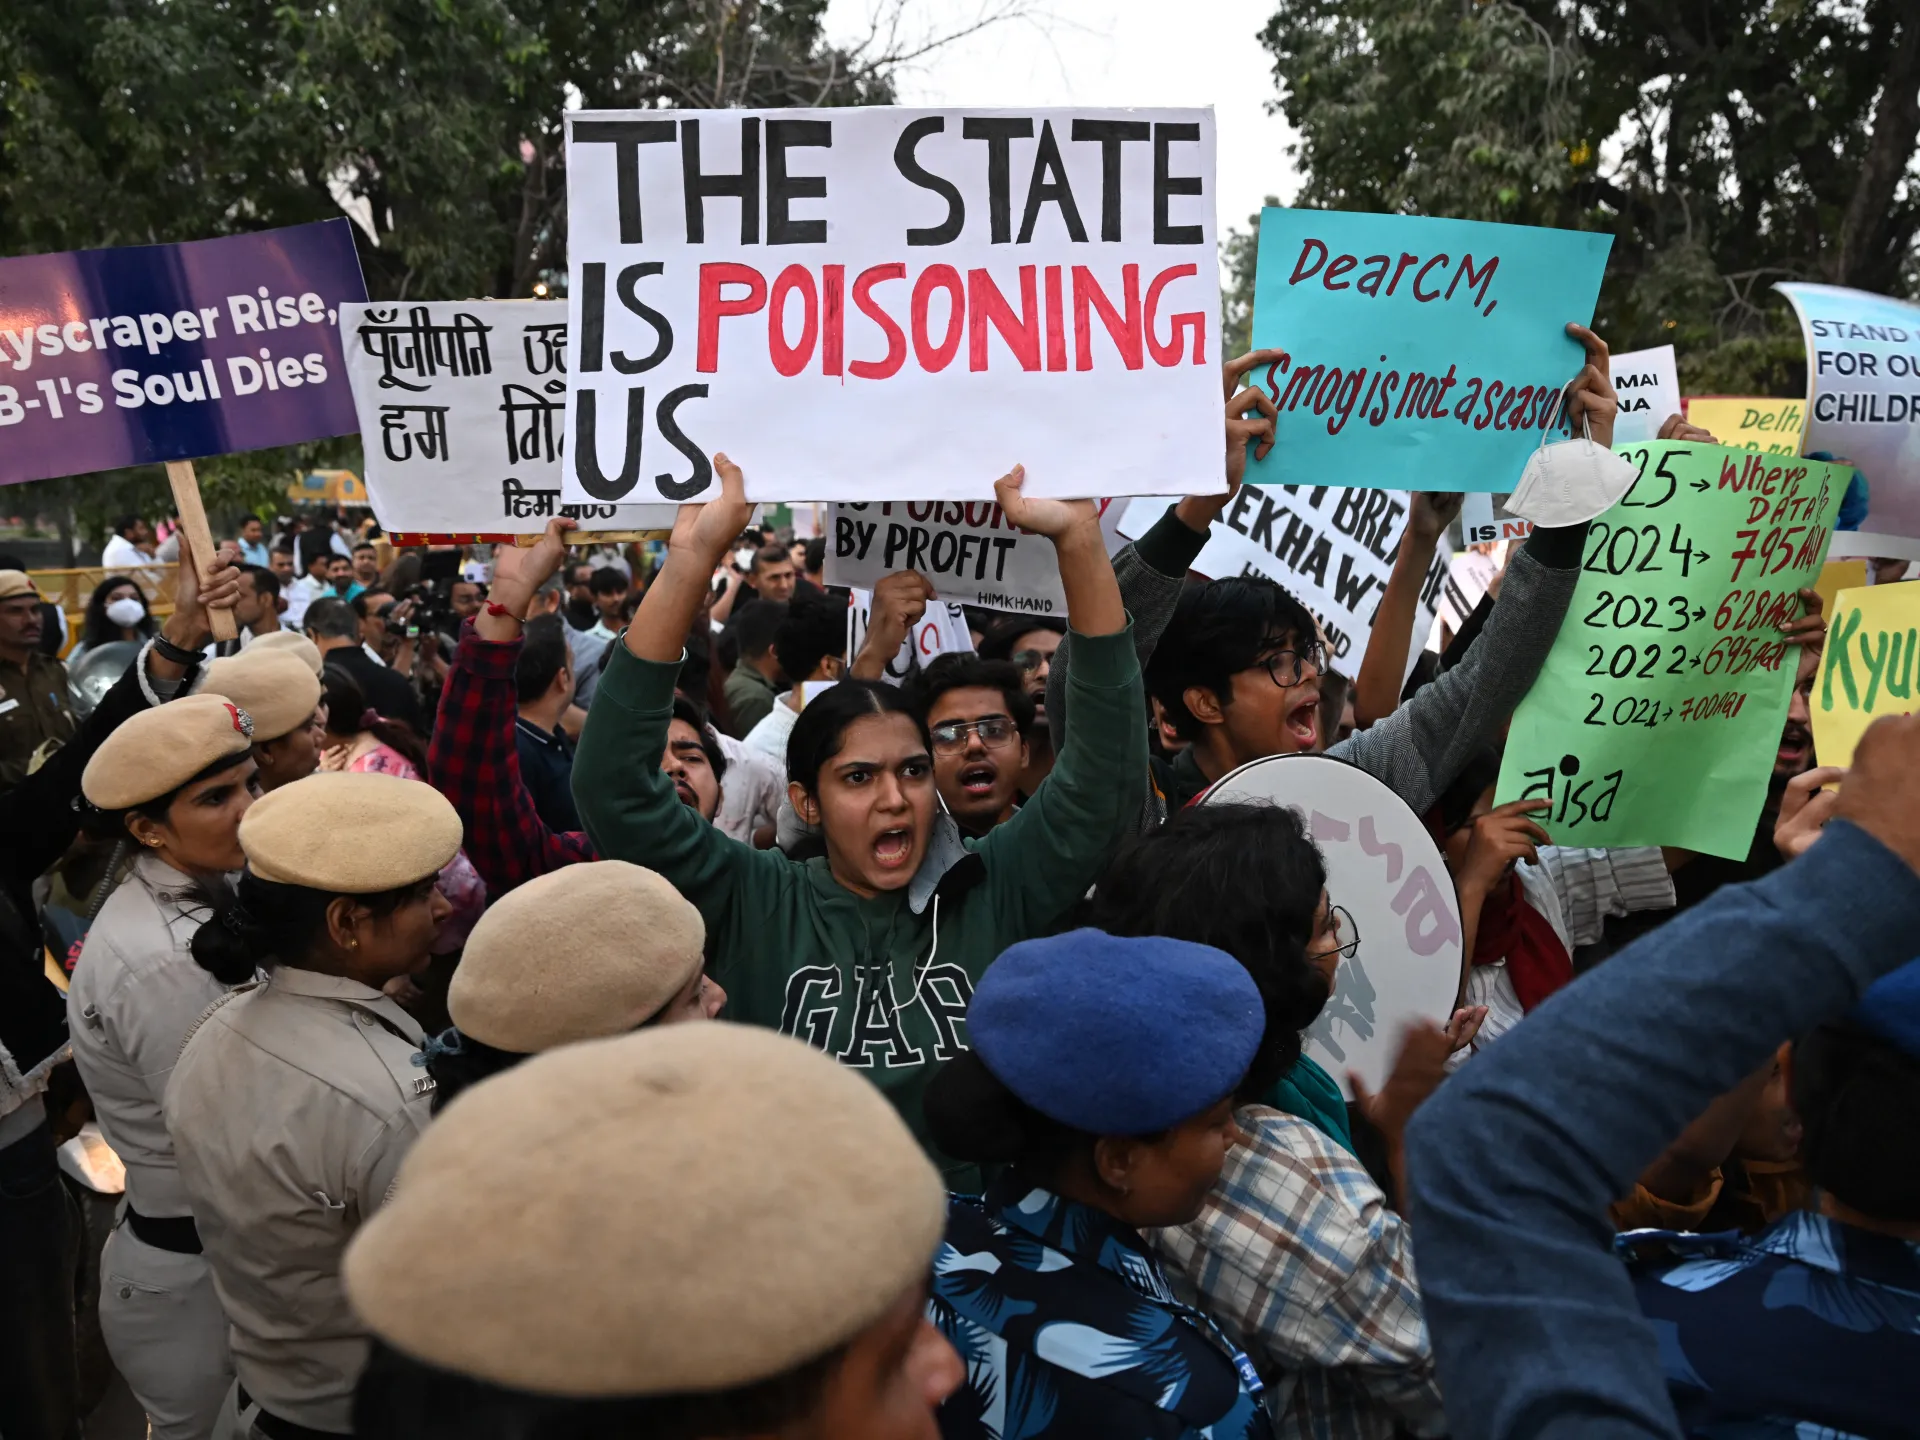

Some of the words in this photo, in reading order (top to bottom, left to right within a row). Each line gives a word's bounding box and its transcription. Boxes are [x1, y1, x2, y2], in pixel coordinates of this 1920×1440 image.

[573, 117, 832, 245] THE
[894, 116, 1204, 246] STATE
[1289, 238, 1419, 298] Dear
[1412, 253, 1500, 317] CM,
[0, 306, 220, 371] yscraper
[227, 285, 338, 335] Rise,
[580, 261, 673, 375] IS
[696, 261, 1207, 384] POISONING
[1811, 319, 1909, 343] STAND
[111, 358, 222, 409] Soul
[227, 347, 328, 397] Dies
[1615, 373, 1658, 390] MAI
[1817, 350, 1878, 376] FOR
[1265, 353, 1367, 436] Smog
[1360, 355, 1400, 427] is
[1394, 364, 1457, 419] not
[1454, 377, 1483, 425] a
[1739, 404, 1802, 434] Delh
[379, 404, 450, 462] हम
[573, 383, 713, 502] US
[1618, 448, 1693, 509] 25
[1717, 454, 1808, 498] Where
[835, 516, 877, 560] BY
[884, 523, 1016, 581] PROFIT
[1213, 484, 1333, 588] EKHA
[1470, 525, 1497, 542] IS
[1583, 522, 1692, 577] 2024
[978, 591, 1053, 612] HIMKHAND
[1583, 590, 1690, 632] 2023
[1585, 644, 1687, 678] 2022
[1821, 607, 1920, 714] Kyu
[1583, 692, 1661, 728] 2021
[1519, 754, 1623, 829] aisa
[778, 960, 975, 1068] GAP
